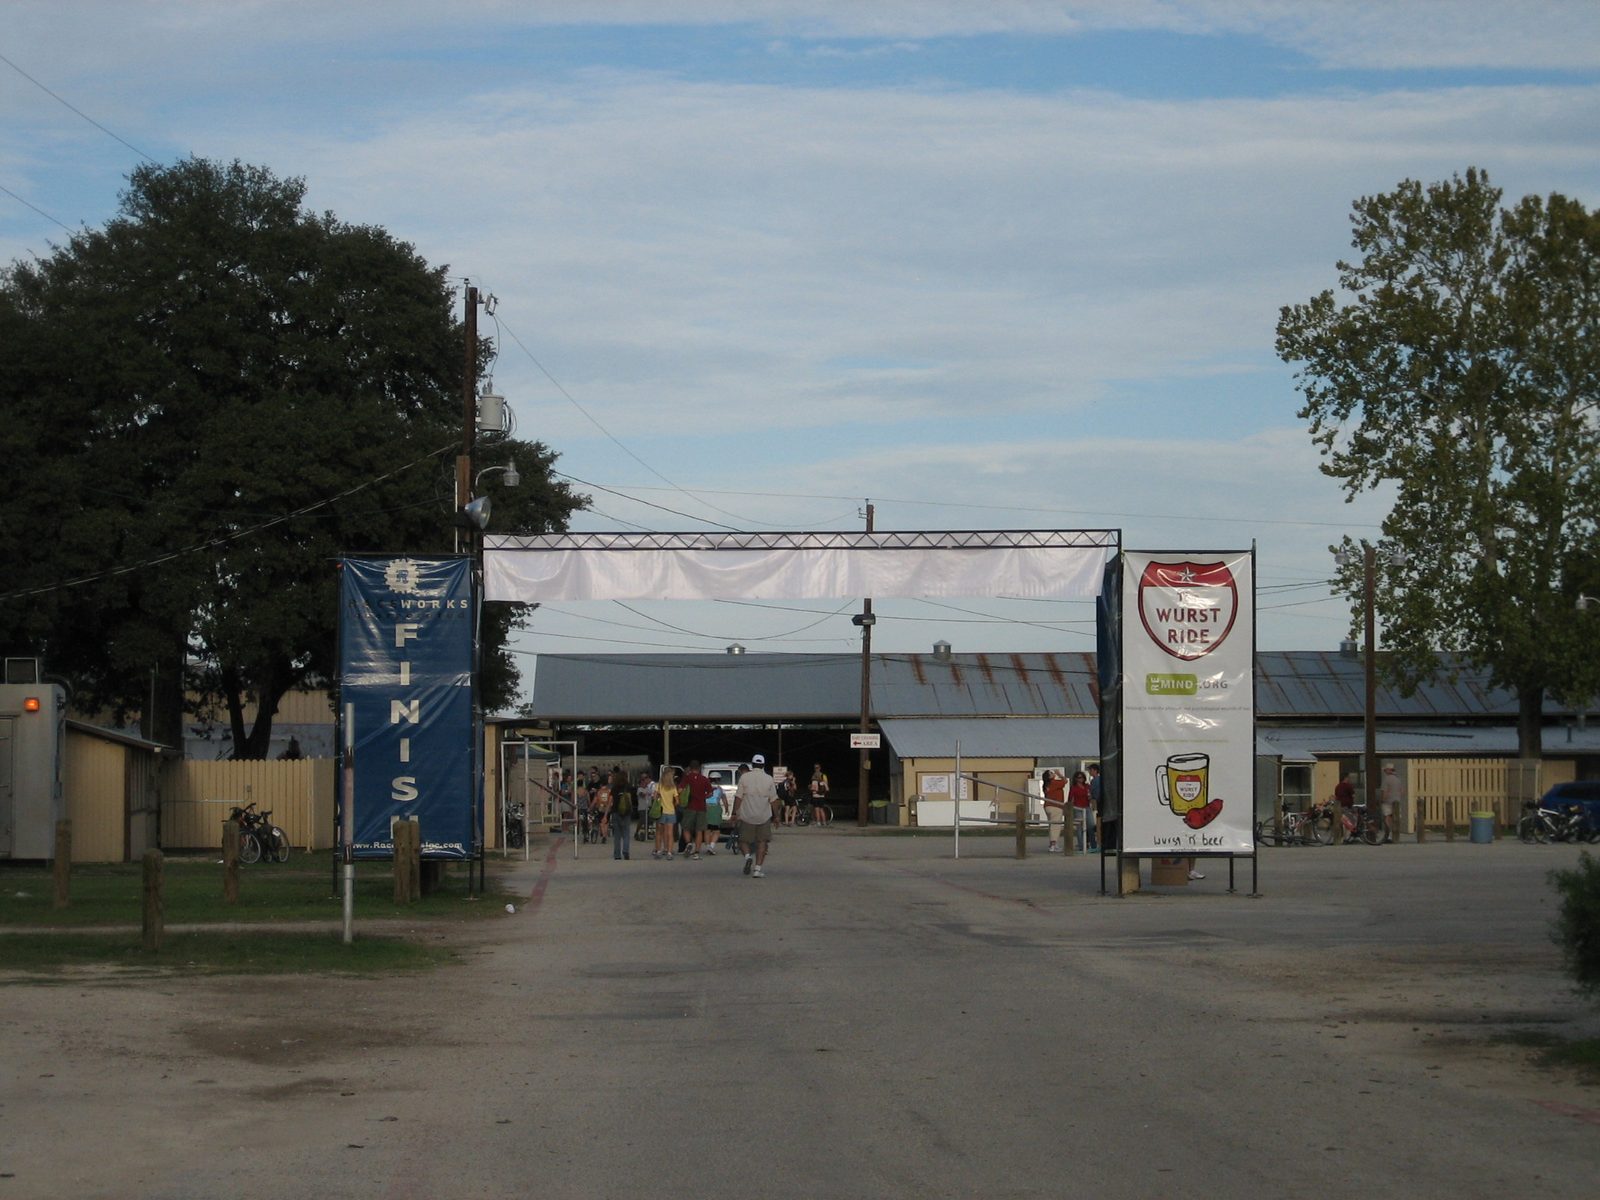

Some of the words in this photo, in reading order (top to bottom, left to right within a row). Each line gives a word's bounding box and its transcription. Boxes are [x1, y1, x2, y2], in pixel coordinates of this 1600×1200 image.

[1156, 608, 1221, 622] WURST
[1168, 629, 1210, 643] RIDE
[1161, 679, 1193, 689] MIND
[1202, 833, 1224, 846] beer
